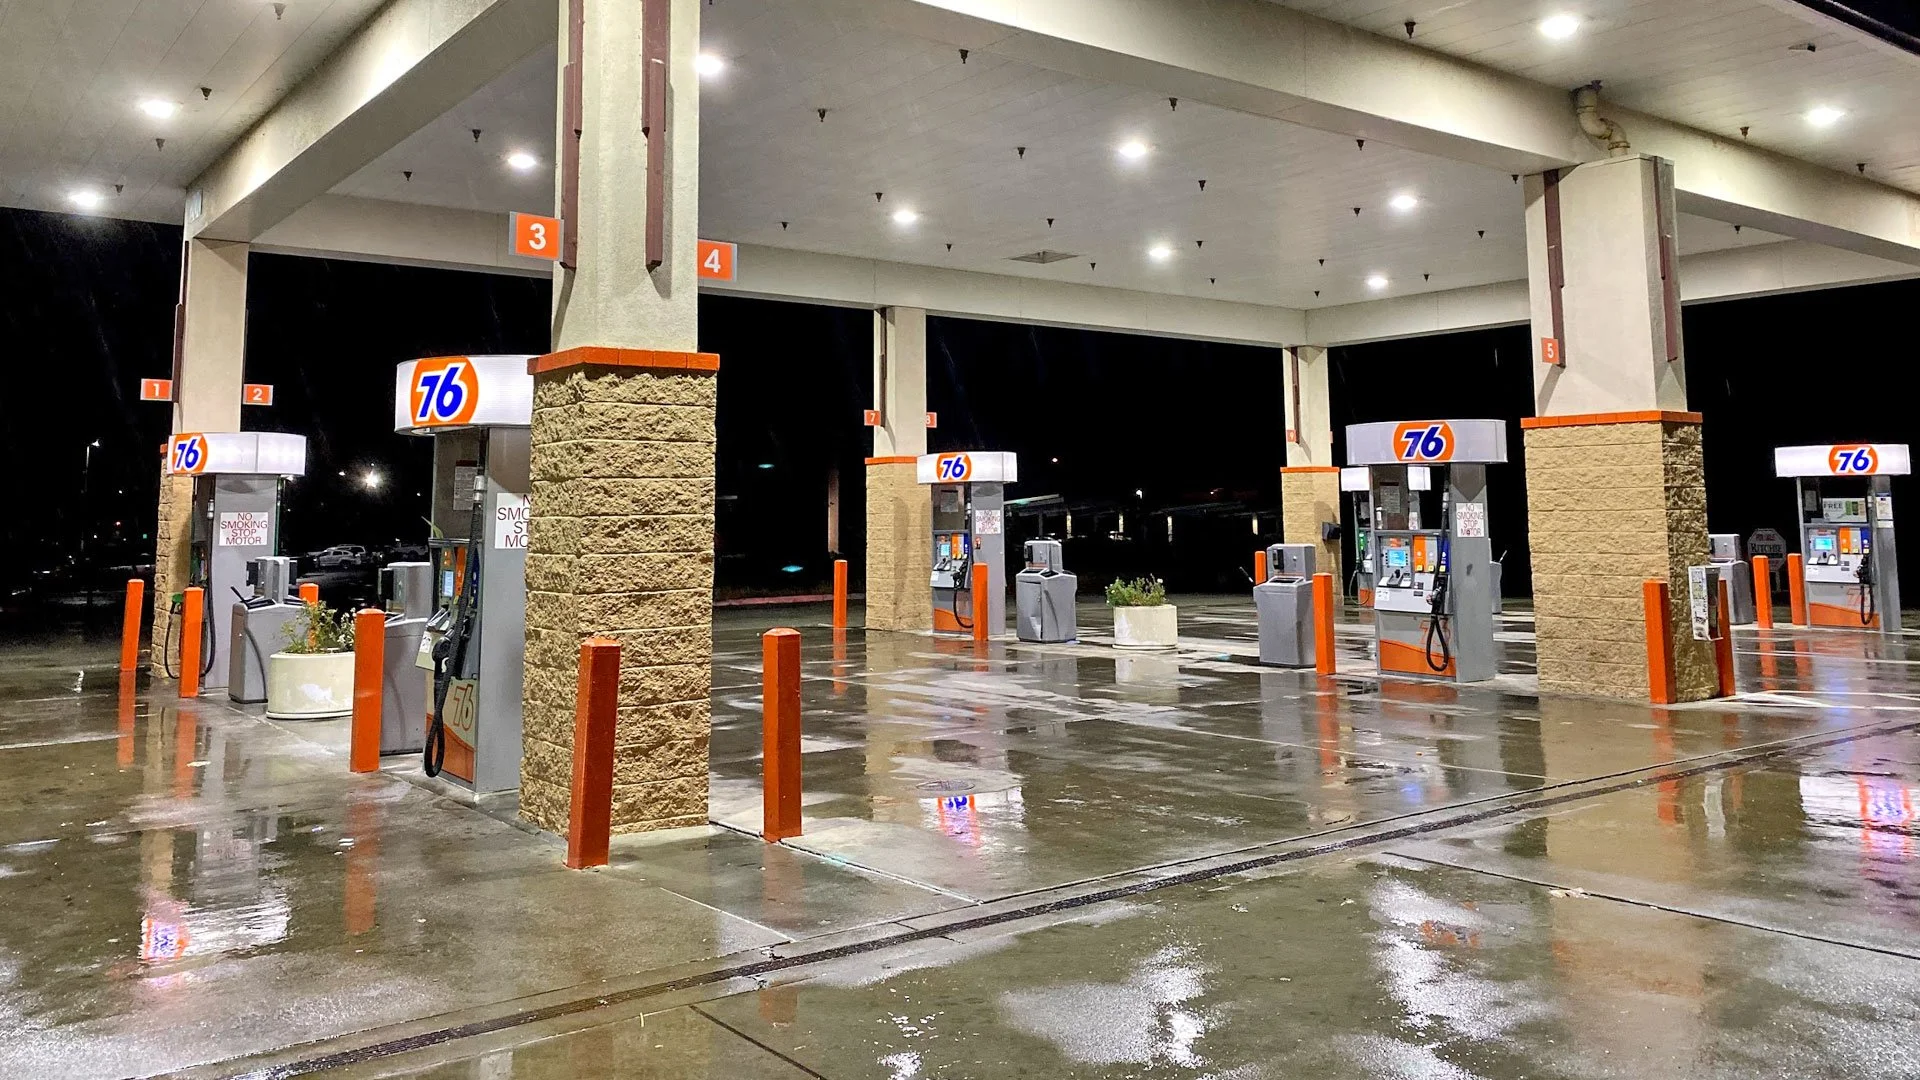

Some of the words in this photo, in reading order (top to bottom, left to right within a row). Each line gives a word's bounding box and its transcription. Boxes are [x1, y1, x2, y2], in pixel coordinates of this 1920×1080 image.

[528, 222, 547, 251] 3
[703, 248, 722, 273] 4
[1547, 342, 1554, 359] 5
[153, 383, 160, 397] 1
[252, 387, 263, 401] 2
[416, 364, 466, 421] 76
[870, 412, 876, 423] 7
[1403, 424, 1446, 460] 76
[175, 437, 200, 470] 76
[1837, 448, 1870, 472] 76
[941, 455, 966, 479] 76
[1465, 503, 1475, 512] NO
[1823, 502, 1843, 510] FREE
[237, 512, 253, 521] NO
[1456, 511, 1484, 520] SMOKING
[220, 520, 268, 530] SMOKING
[1463, 519, 1478, 528] STOP
[231, 528, 257, 538] STOP
[1460, 527, 1482, 536] MOTOR
[225, 537, 262, 545] MOTOR
[453, 683, 474, 731] 76
